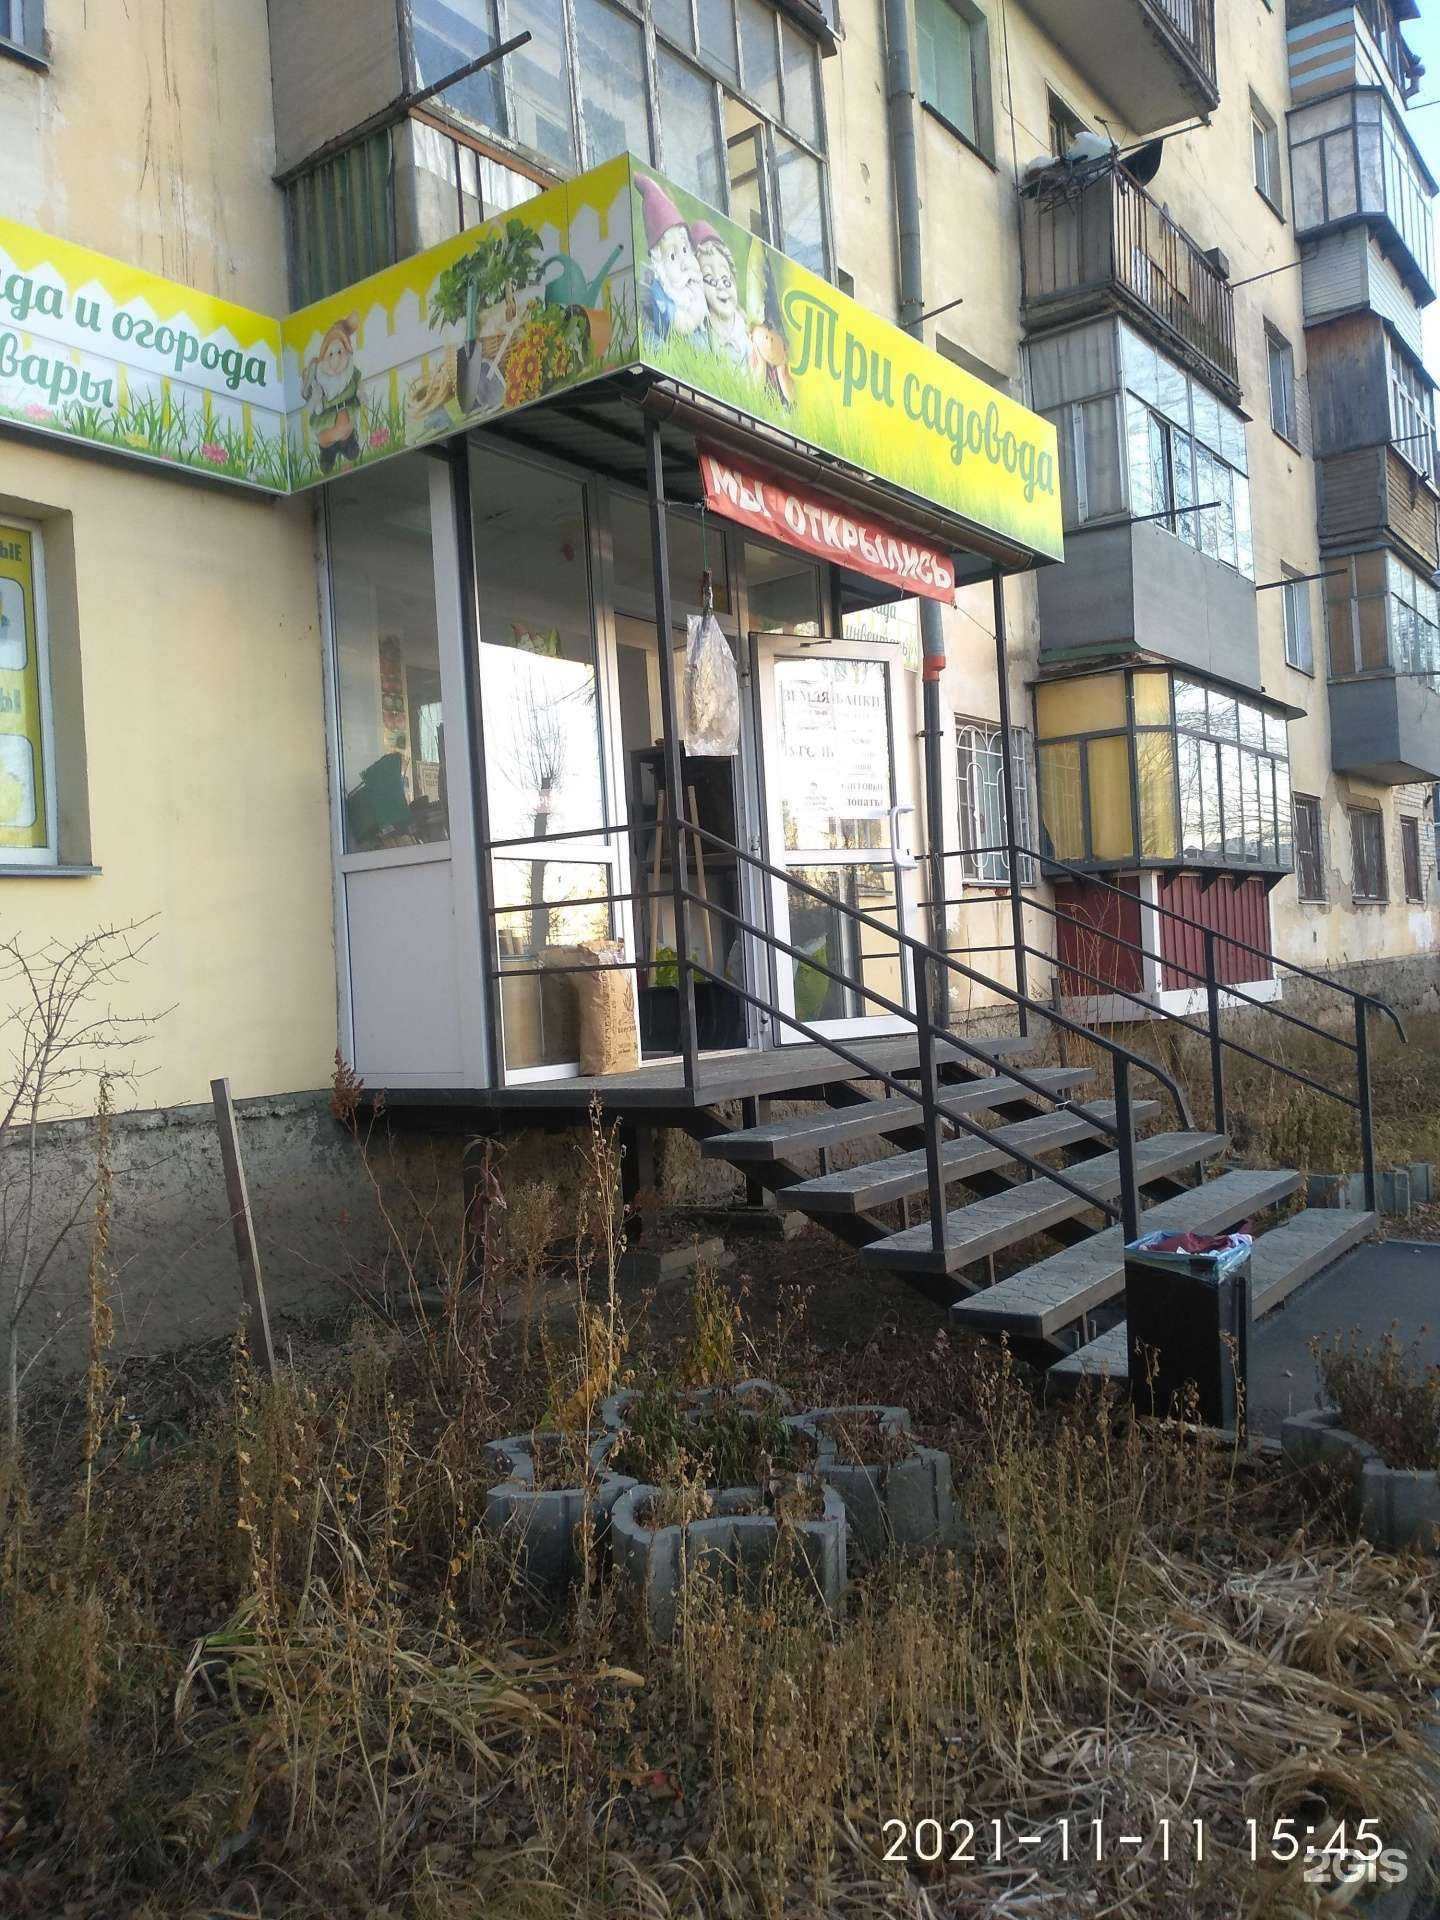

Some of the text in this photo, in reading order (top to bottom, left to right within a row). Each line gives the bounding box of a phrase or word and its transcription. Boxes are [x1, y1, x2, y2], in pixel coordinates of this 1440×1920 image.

[0, 273, 267, 391] да и огорода
[783, 289, 1055, 504] Три садовода
[710, 458, 953, 590] МЫ ОТКРЫЛИСЬ
